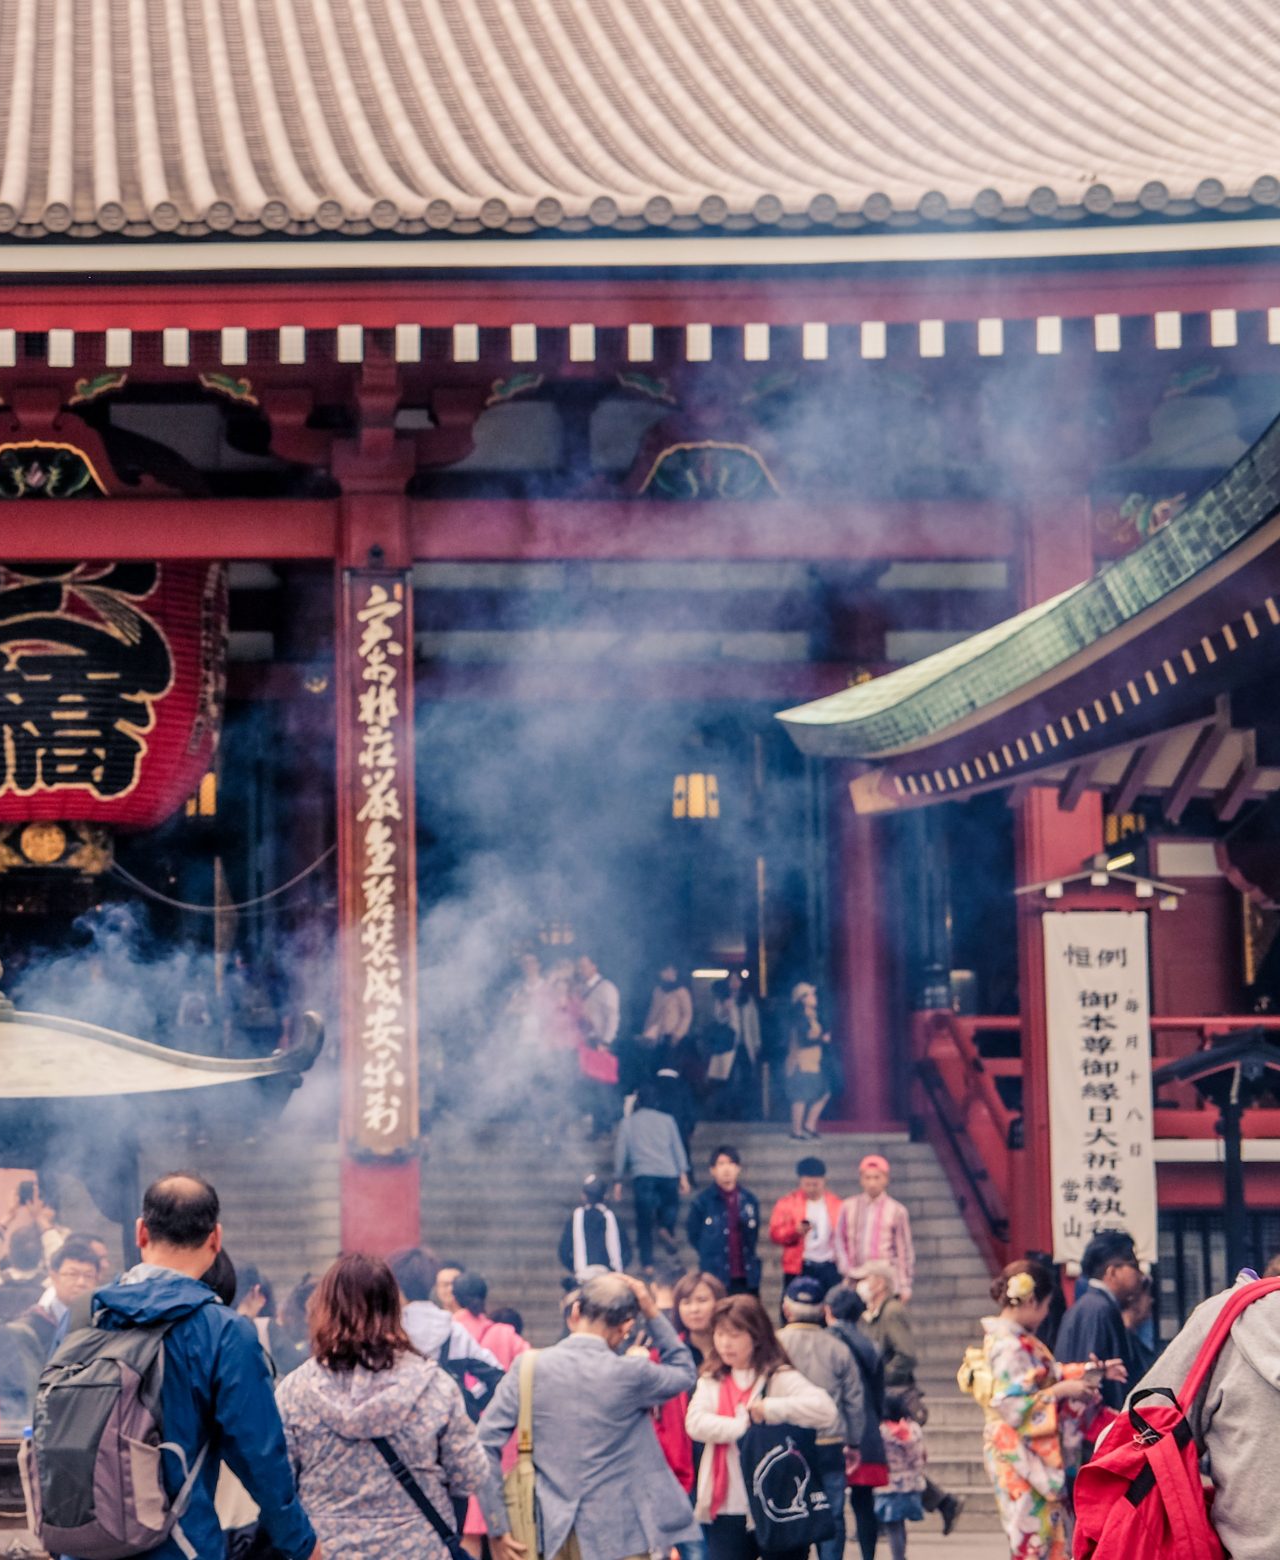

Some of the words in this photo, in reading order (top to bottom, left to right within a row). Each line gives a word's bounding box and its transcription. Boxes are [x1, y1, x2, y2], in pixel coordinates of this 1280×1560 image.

[1063, 943, 1128, 969] 恒例
[1124, 989, 1143, 1158] 毎月十八日
